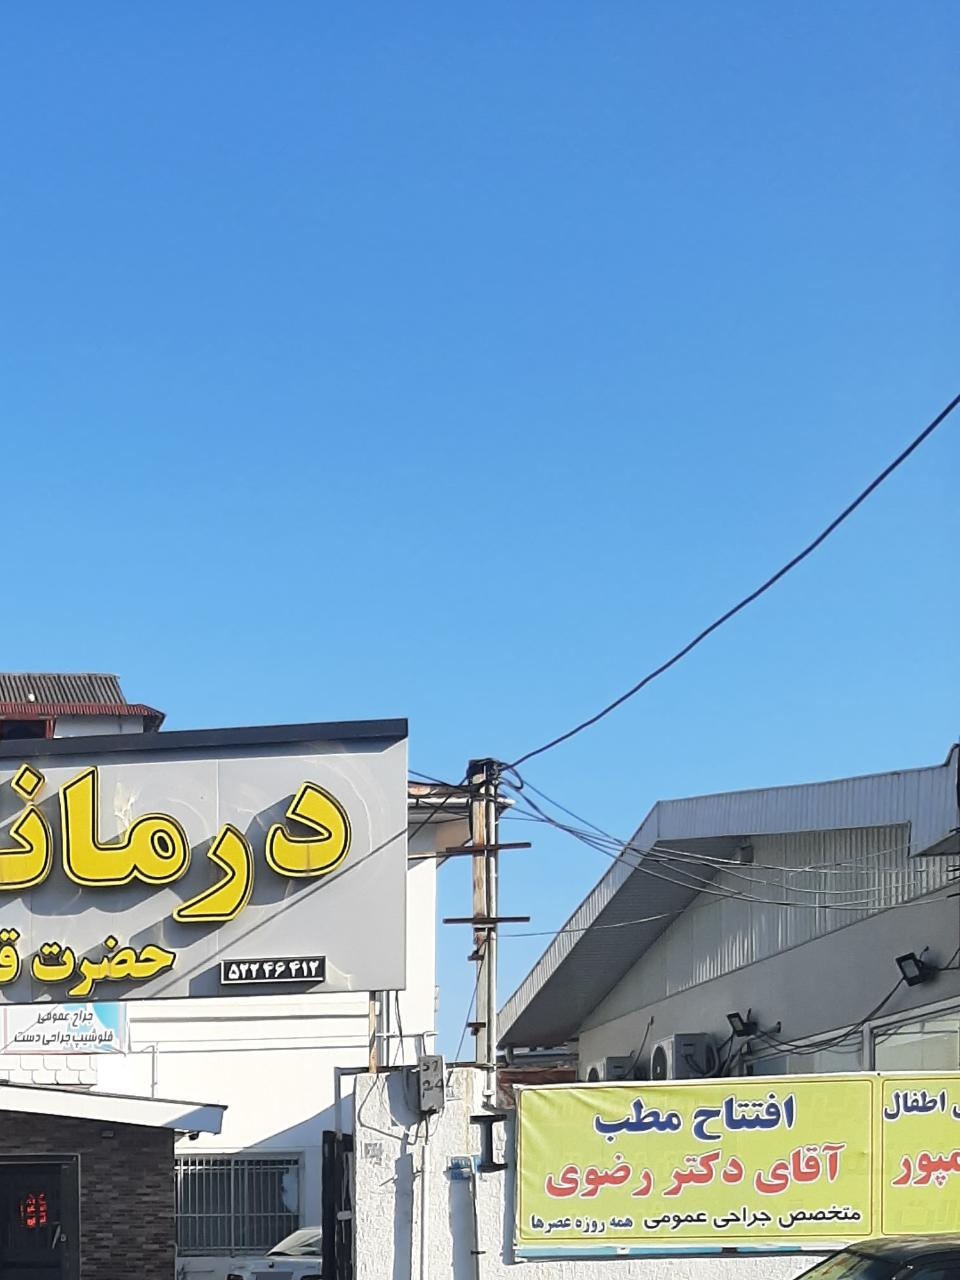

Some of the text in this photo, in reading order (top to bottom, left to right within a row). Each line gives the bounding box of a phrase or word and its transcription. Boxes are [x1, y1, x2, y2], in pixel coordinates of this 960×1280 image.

[32, 935, 176, 998] حضرت
[594, 1092, 796, 1143] افتتاح مطب
[884, 1090, 946, 1119] اطفال
[546, 1143, 846, 1198] آقای دکتر رضوی
[892, 1152, 960, 1187] مپور
[531, 1206, 861, 1233] متخصص جراحی عمومی همه روزه عصرها
